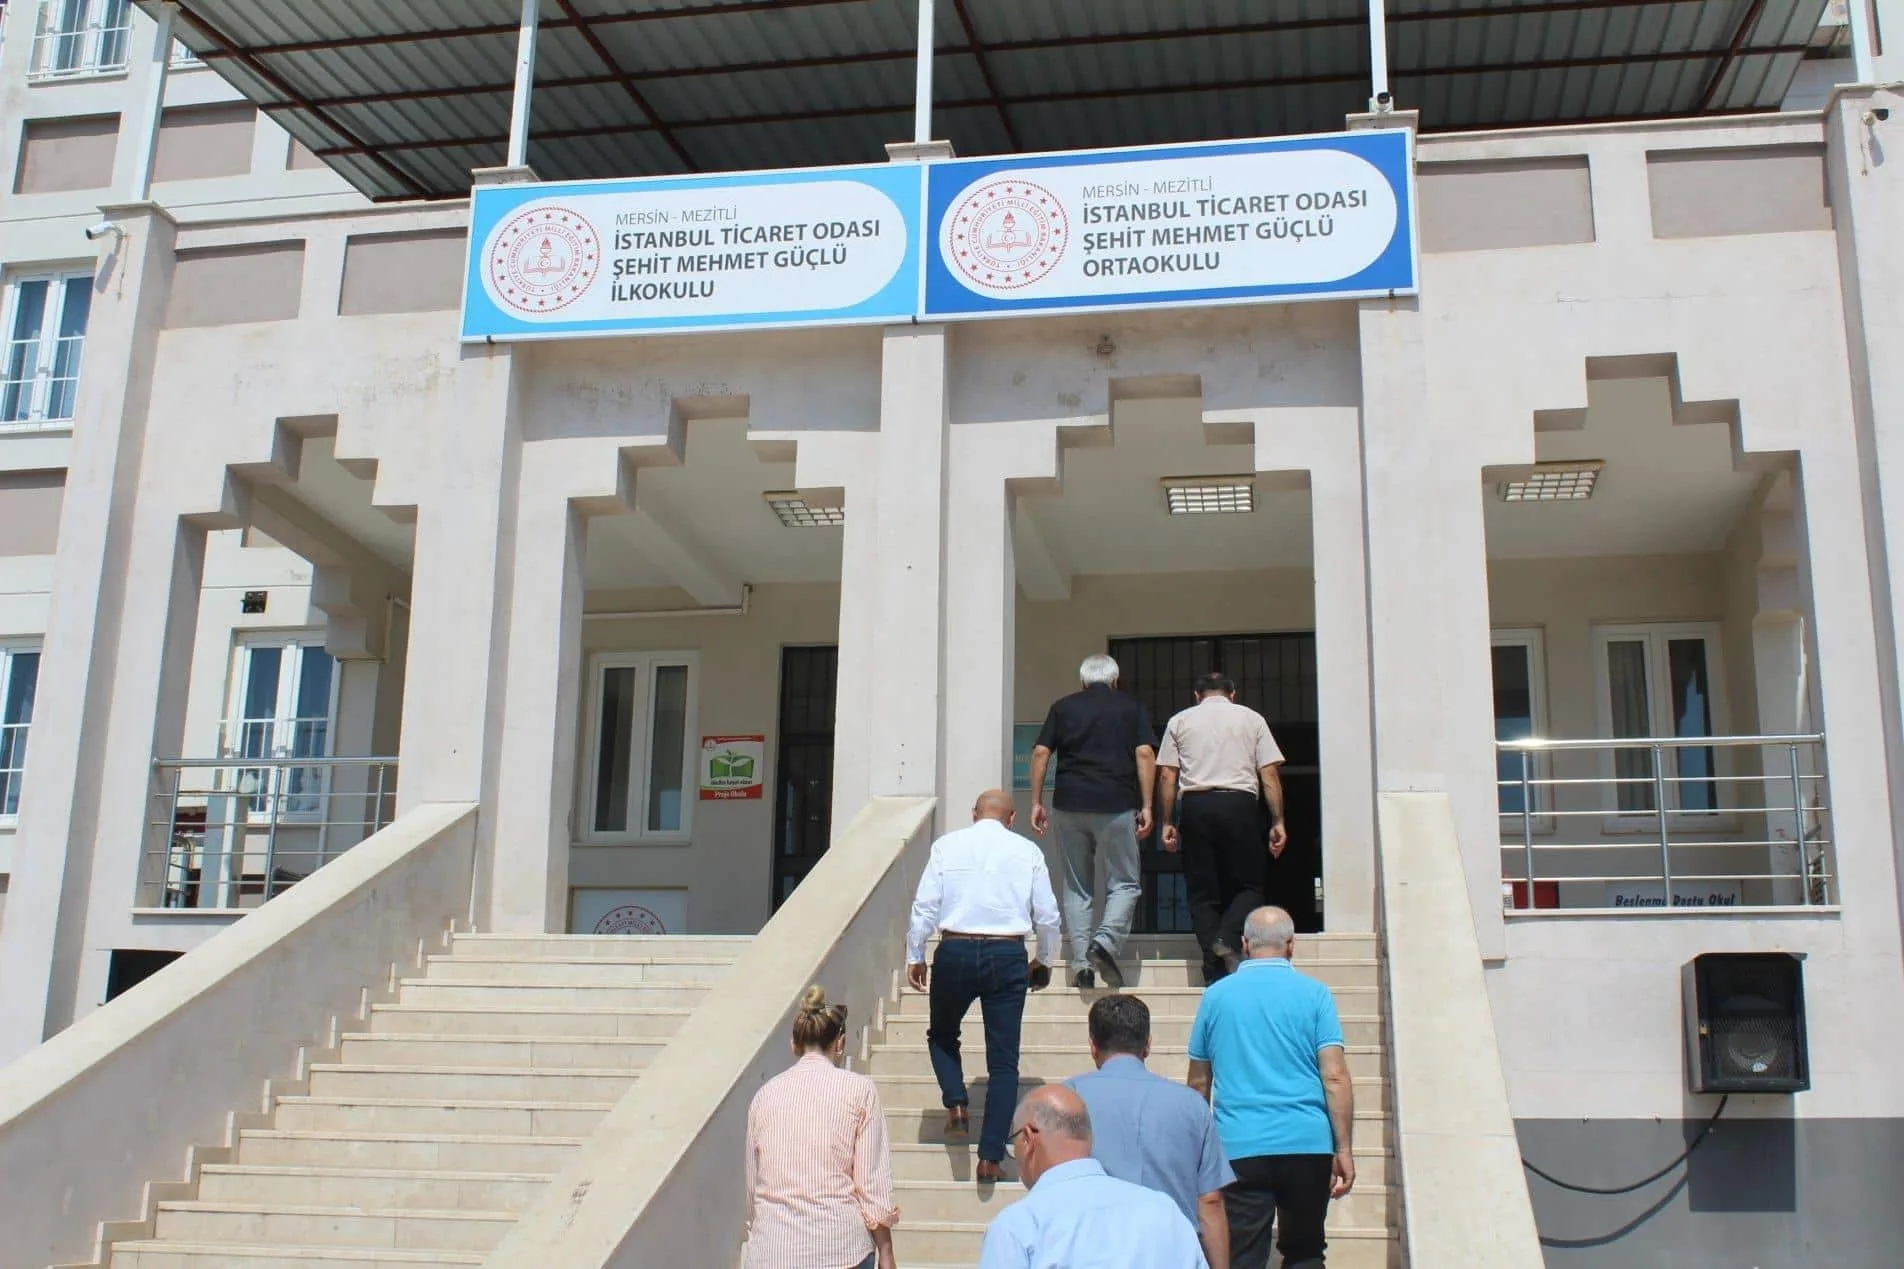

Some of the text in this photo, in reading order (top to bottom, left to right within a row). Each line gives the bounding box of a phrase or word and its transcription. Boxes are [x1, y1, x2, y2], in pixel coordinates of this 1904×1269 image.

[1082, 180, 1140, 199] MERSİN
[1153, 175, 1213, 195] MEZİTLİ
[615, 209, 669, 226] MERSİN
[681, 205, 737, 223] MEZİTLİ
[1083, 189, 1367, 224] İSTANBUL TİCARET ODASI
[614, 219, 880, 250] İSTANBUL TİCARET ODASI
[1083, 213, 1334, 255] ŞEHİT MEHMET GÜÇLÜ
[612, 242, 847, 280] ŞEHİT MEHMET GÜÇLÜ
[1082, 251, 1220, 277] ORTAOKULU
[611, 280, 714, 302] İLKOKULU
[1708, 892, 1736, 907] Okul
